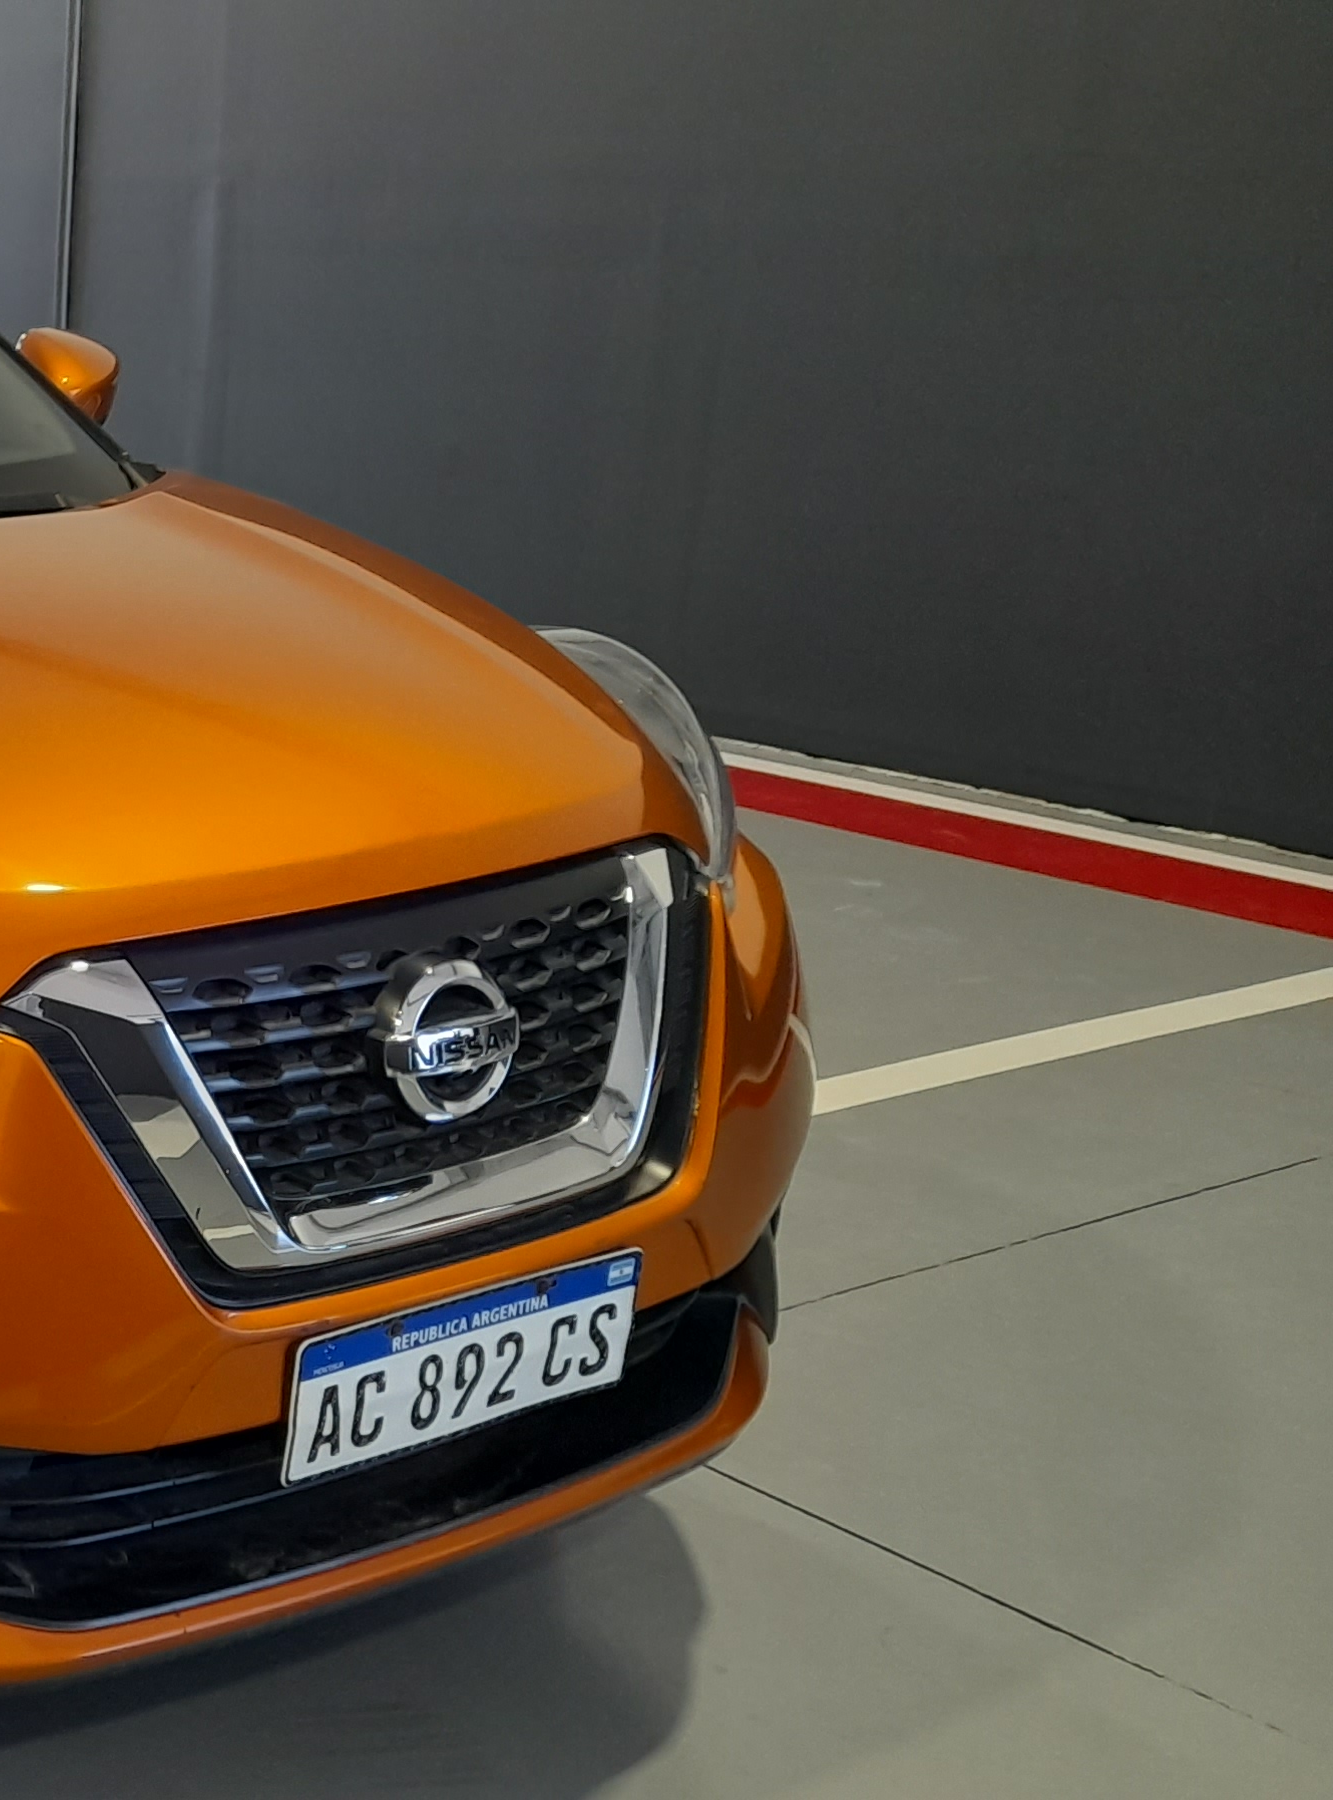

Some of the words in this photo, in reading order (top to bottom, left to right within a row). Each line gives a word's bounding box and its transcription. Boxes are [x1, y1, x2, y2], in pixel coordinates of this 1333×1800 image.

[409, 1028, 516, 1071] NISSAN
[392, 1316, 469, 1352] REPUBLICA
[471, 1294, 549, 1329] ARGENTINA
[307, 1370, 386, 1464] AC
[410, 1332, 524, 1431] 892
[541, 1303, 618, 1387] CS
